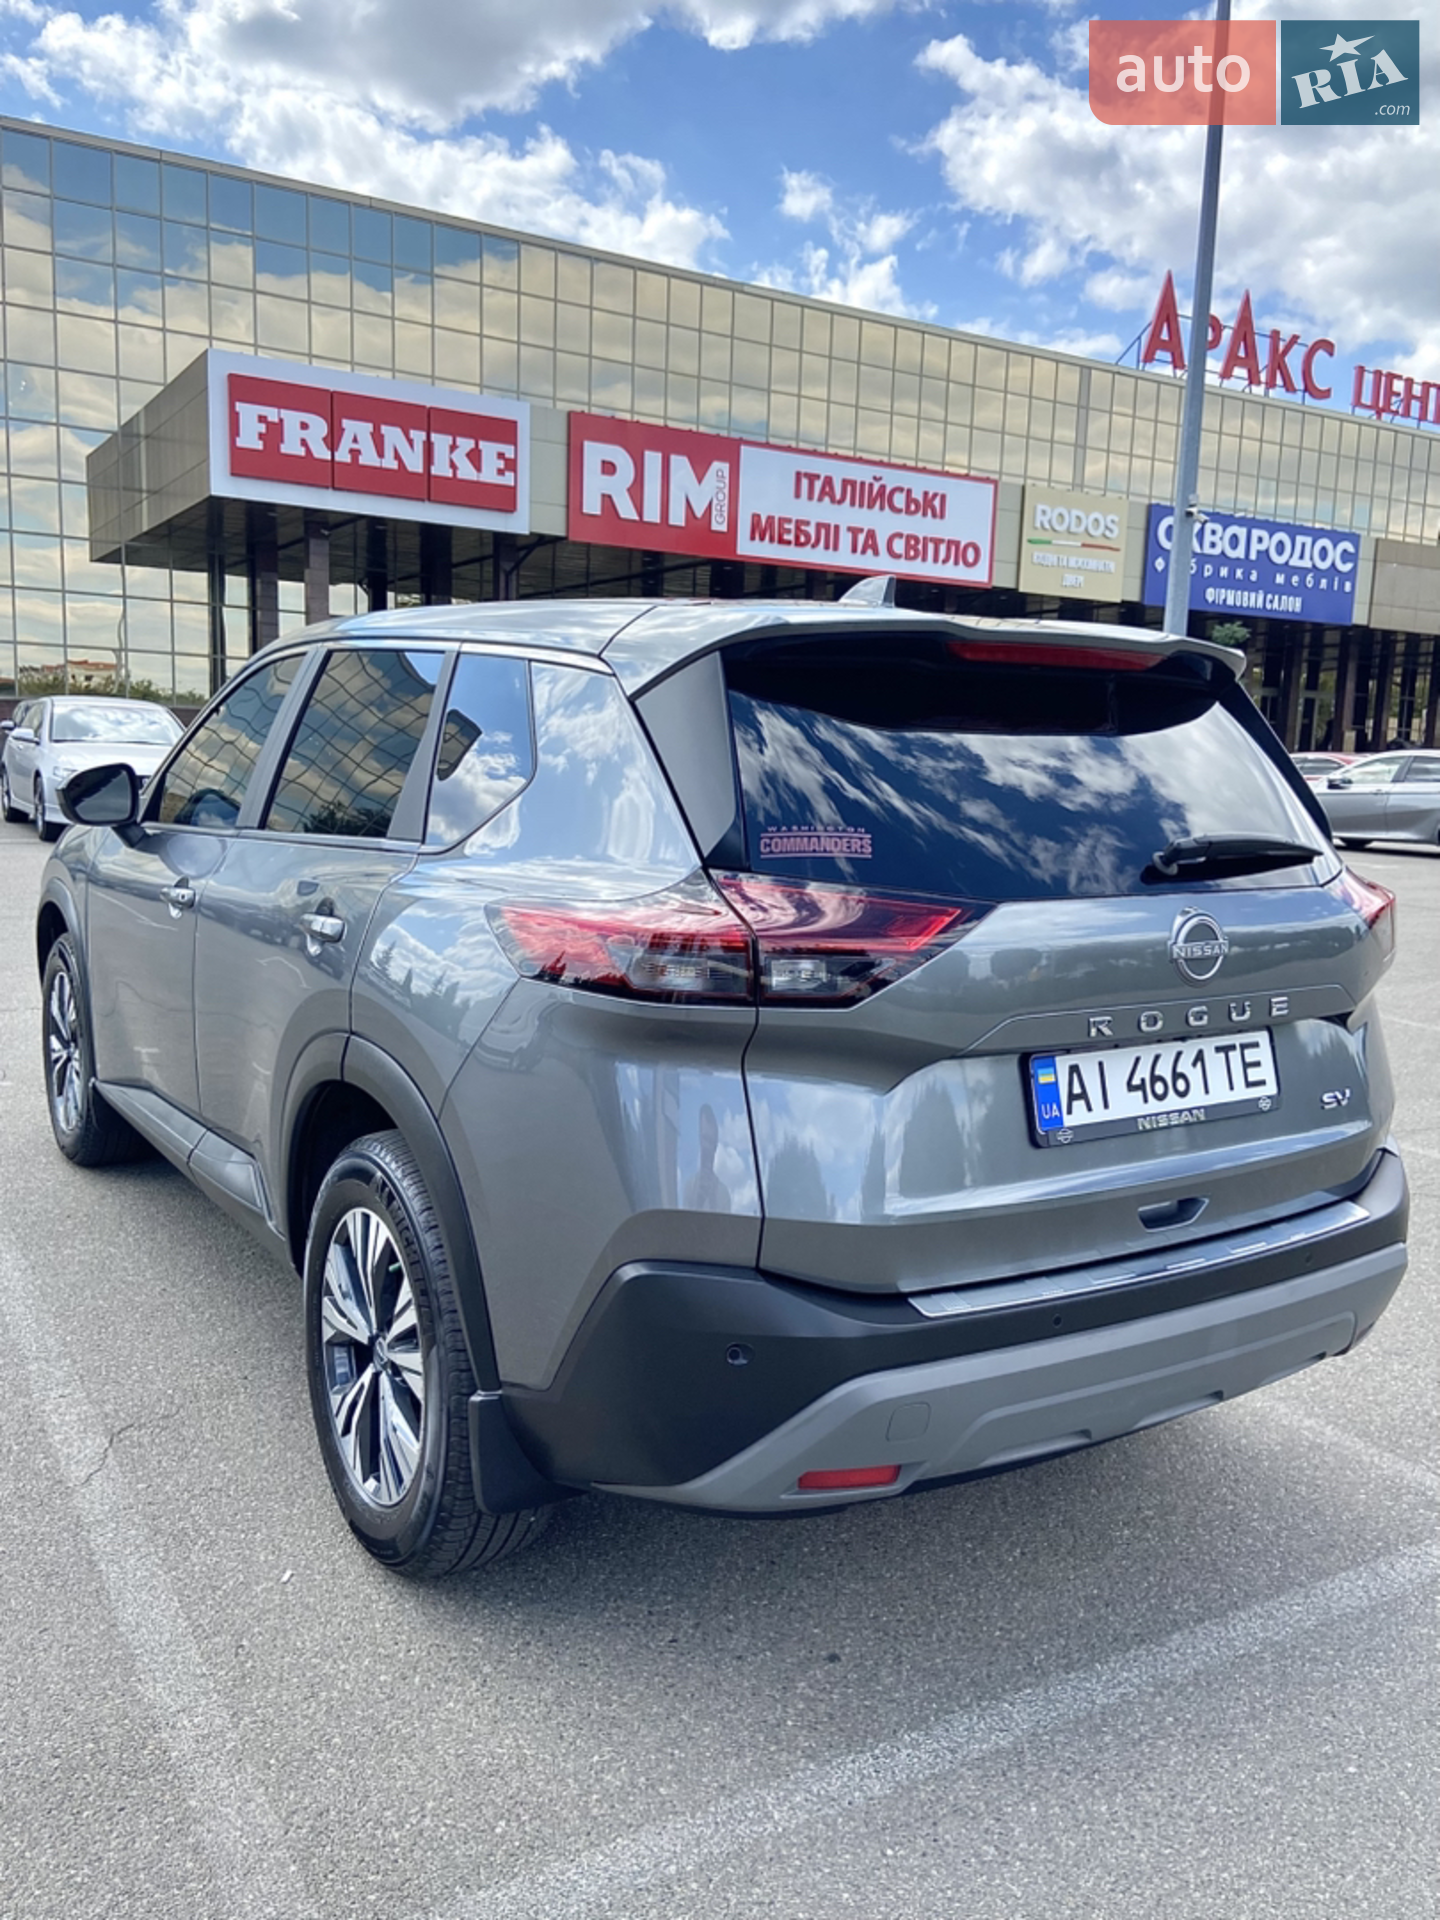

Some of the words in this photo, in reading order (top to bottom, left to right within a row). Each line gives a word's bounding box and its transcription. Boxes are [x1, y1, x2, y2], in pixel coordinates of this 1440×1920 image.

[235, 401, 516, 488] FRANKE
[582, 439, 730, 533] RIM
[714, 468, 728, 526] GROUP
[794, 471, 947, 520] ІТАЛІЙСЬКІ
[750, 512, 841, 552] МЕБЛІ
[847, 526, 881, 558] ТА
[886, 532, 982, 569] СВІТЛО
[1034, 504, 1120, 540] RODOS
[1205, 587, 1265, 611] ФІРМОВИЙ
[1265, 593, 1304, 614] САЛОН
[760, 837, 873, 854] COMMANDERS
[1172, 941, 1229, 960] NISSAN
[1089, 996, 1290, 1038] ROGUE
[1066, 1060, 1110, 1116] AI
[1126, 1048, 1210, 1104] 4661
[1214, 1041, 1267, 1092] TE
[1041, 1102, 1061, 1120] UA
[1321, 1088, 1351, 1110] SV
[1137, 1107, 1206, 1131] NISSAN
